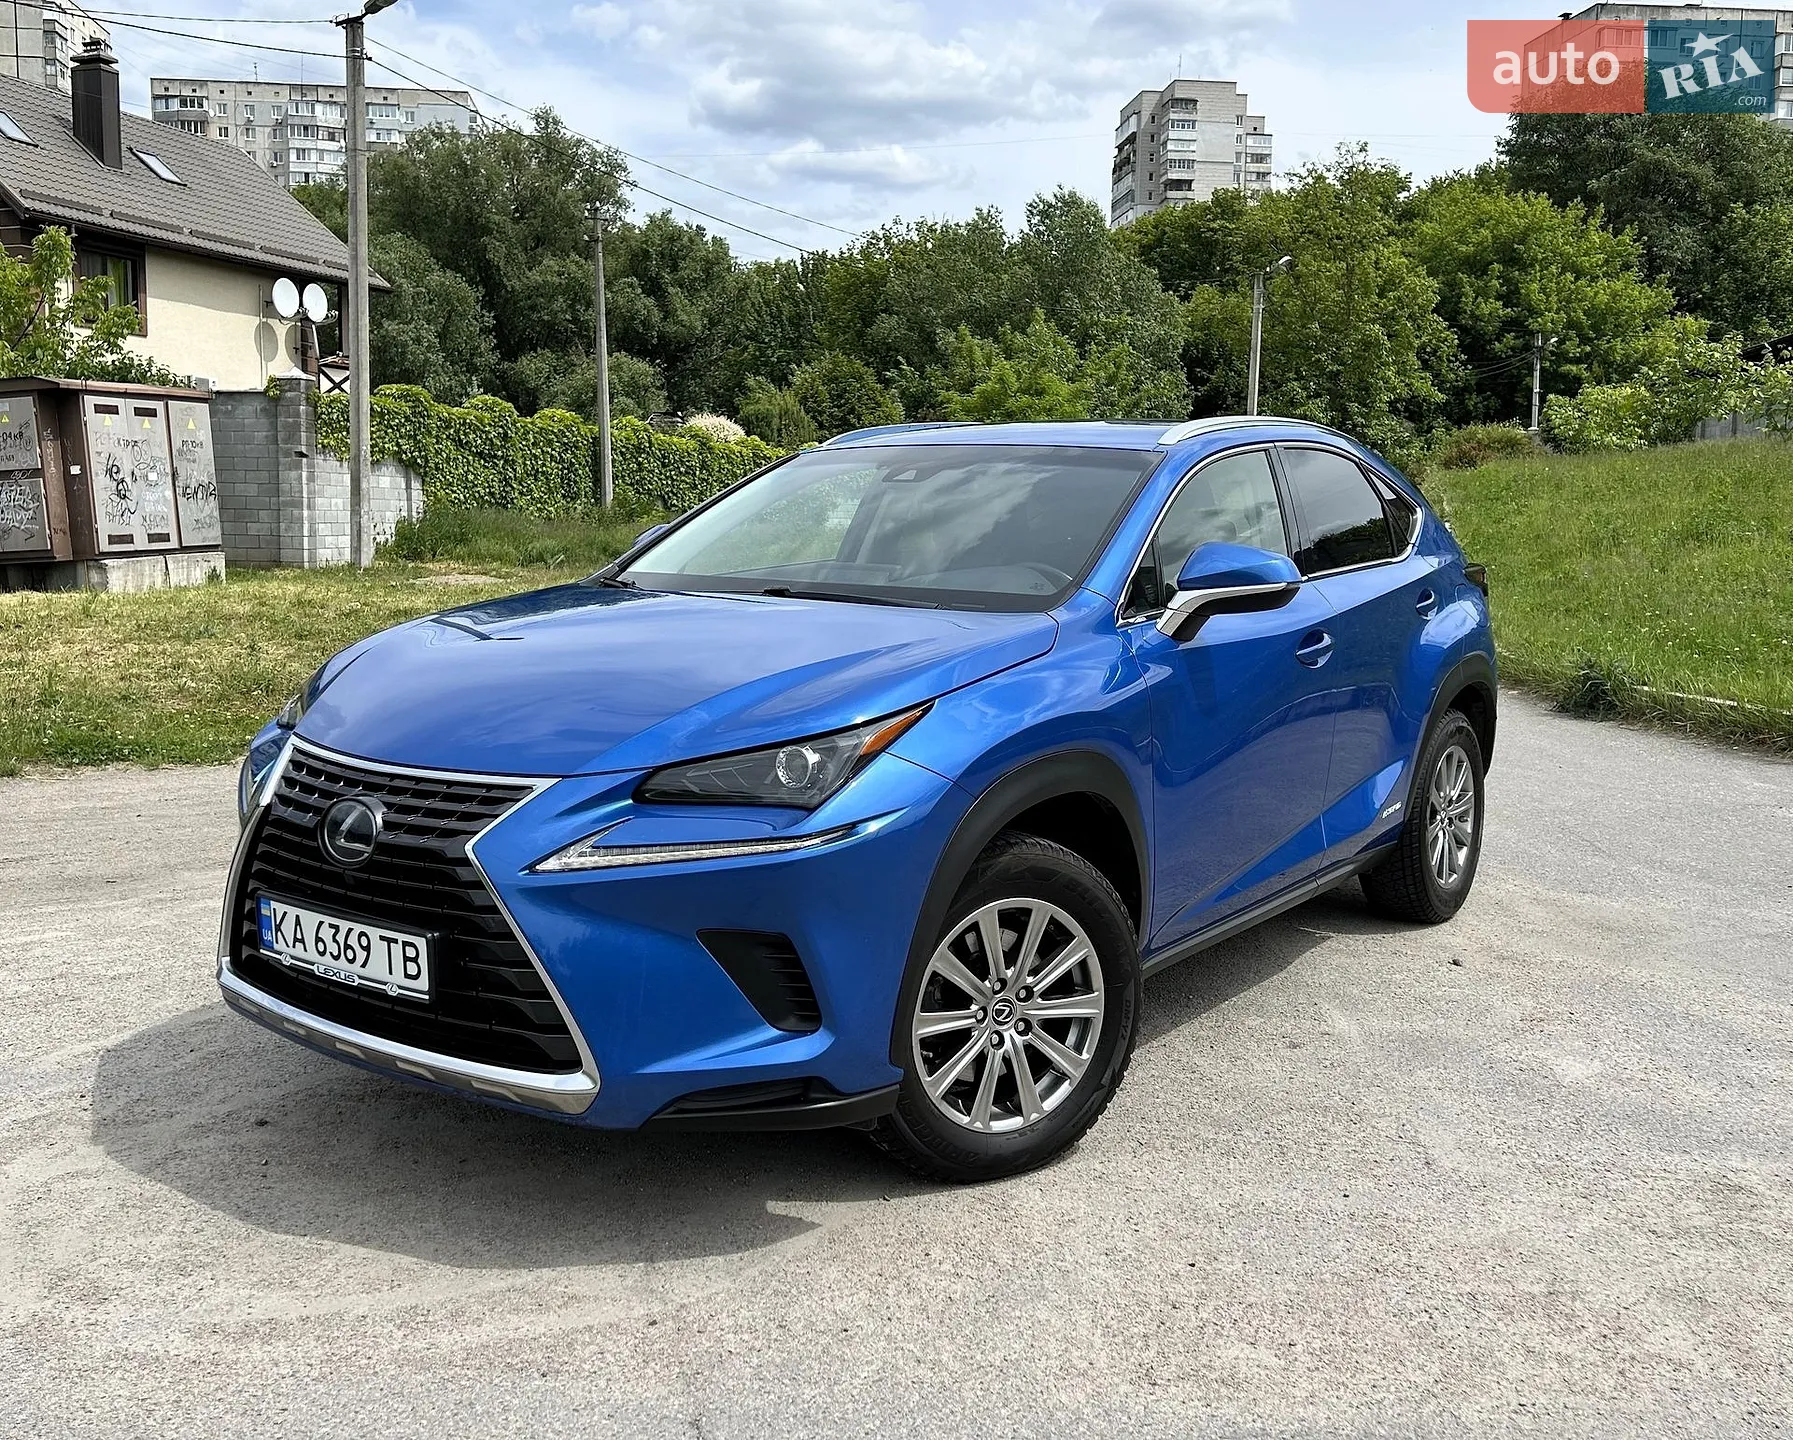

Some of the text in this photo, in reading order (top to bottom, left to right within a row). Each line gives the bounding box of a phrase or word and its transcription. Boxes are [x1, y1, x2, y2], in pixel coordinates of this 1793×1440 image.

[262, 928, 273, 942] UA
[273, 907, 422, 981] KA 6369 TB
[316, 965, 357, 983] LEXUS
